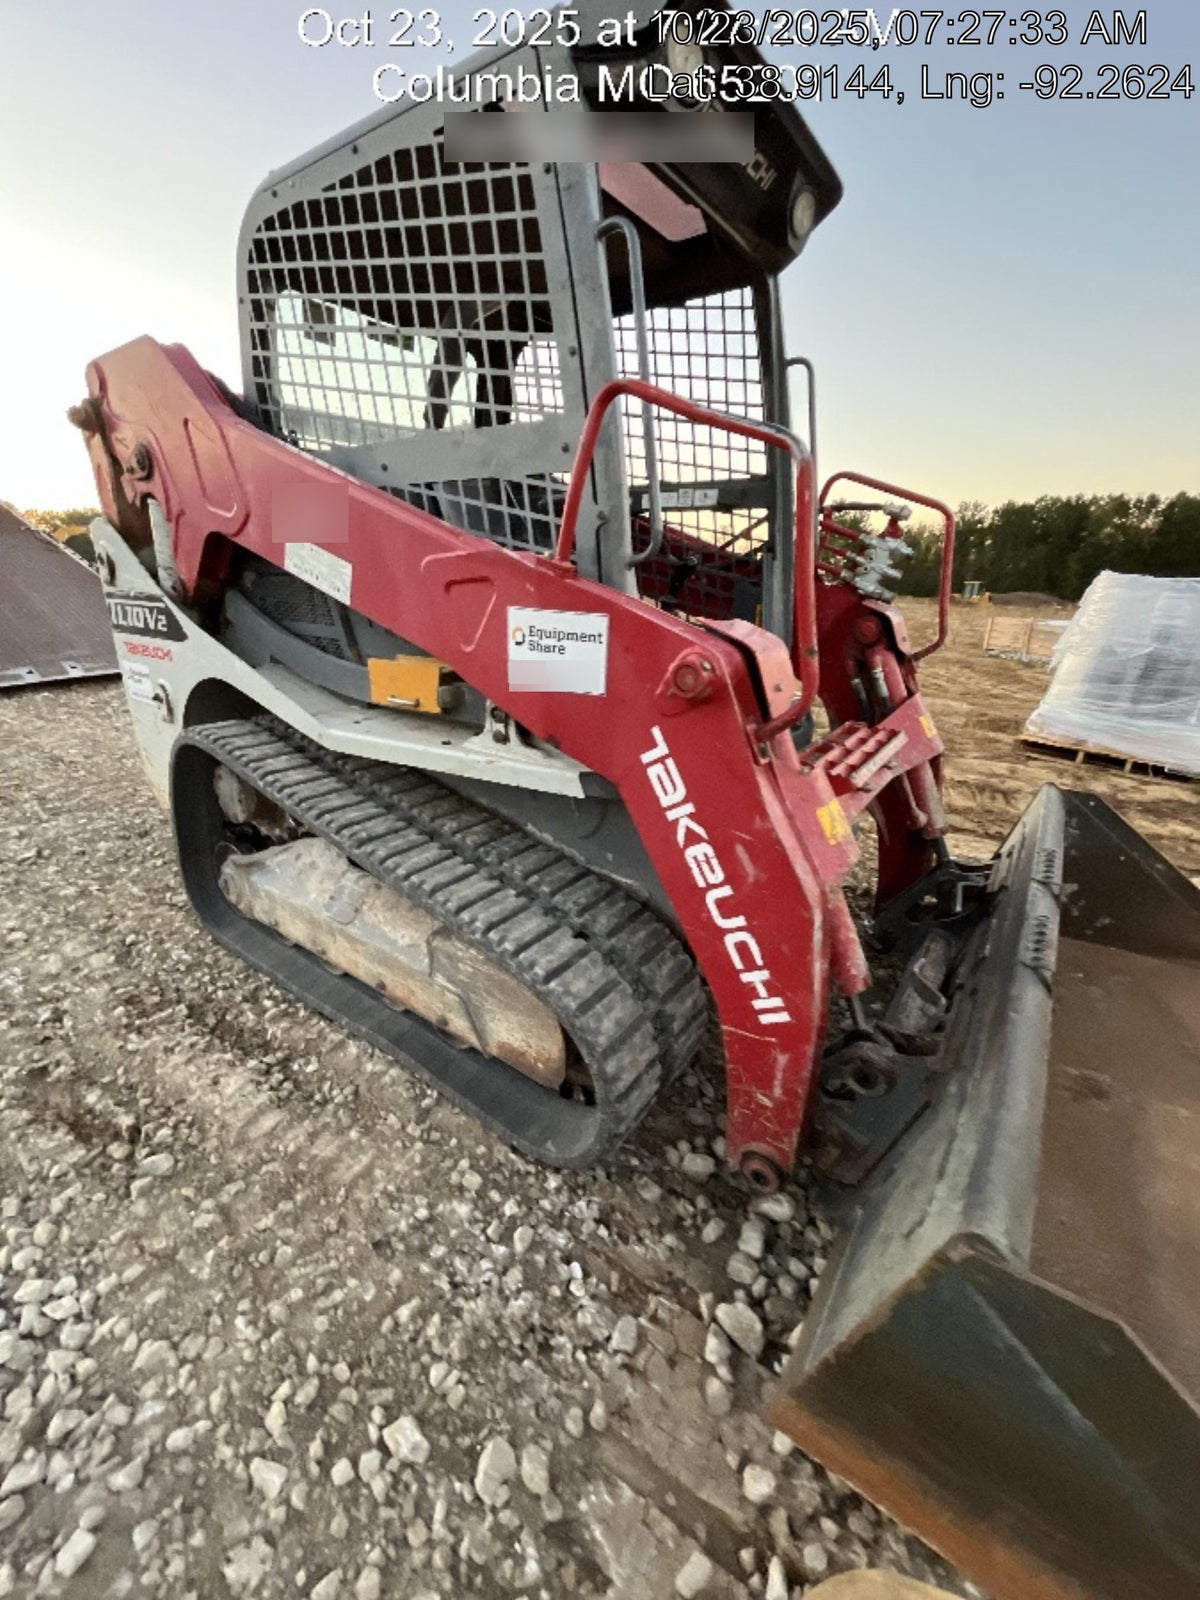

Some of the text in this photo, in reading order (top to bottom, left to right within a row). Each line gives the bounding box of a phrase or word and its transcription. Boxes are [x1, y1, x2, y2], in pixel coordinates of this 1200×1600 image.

[528, 625, 604, 645] Equipment
[528, 640, 567, 655] Share
[639, 725, 793, 1026] TAKEUCHI
